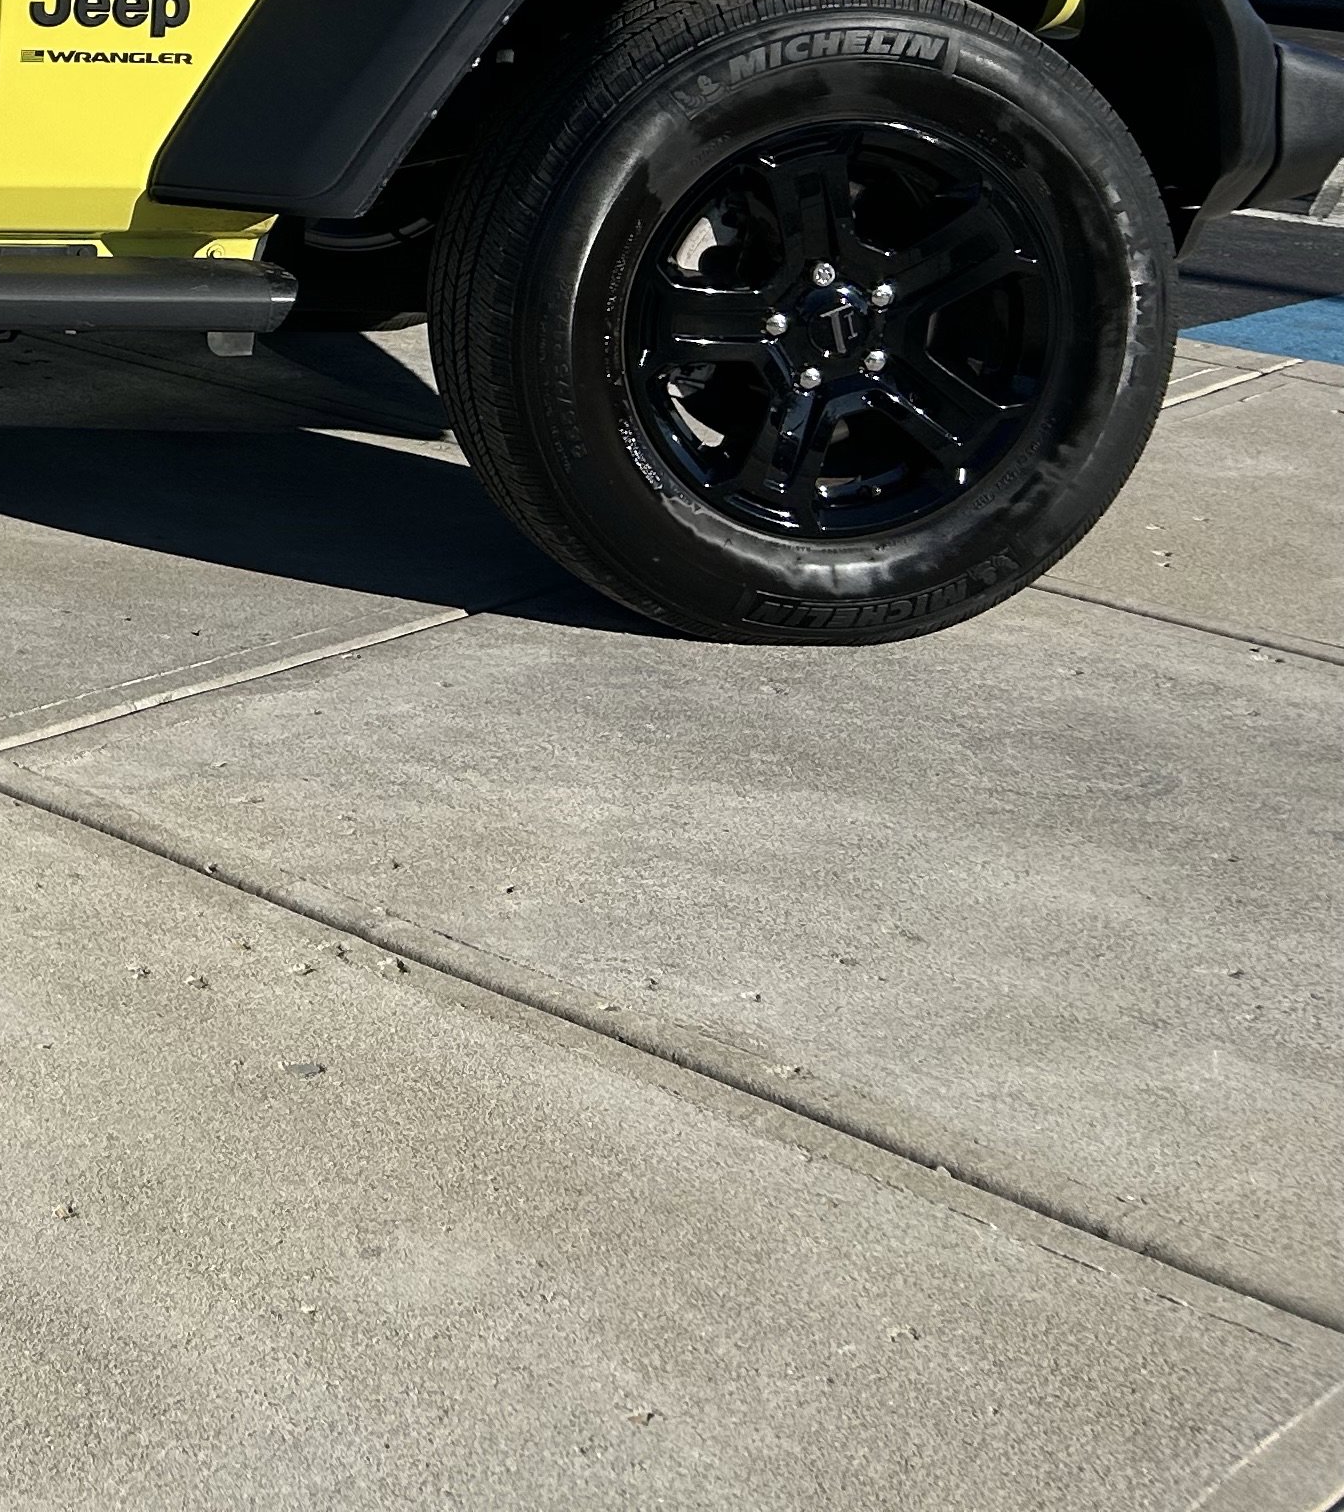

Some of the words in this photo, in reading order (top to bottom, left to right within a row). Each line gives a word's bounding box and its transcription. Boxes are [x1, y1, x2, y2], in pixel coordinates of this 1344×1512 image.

[47, 49, 193, 65] WRANGLER
[727, 29, 946, 85] MICHELIN
[750, 577, 969, 629] MICHELIN
